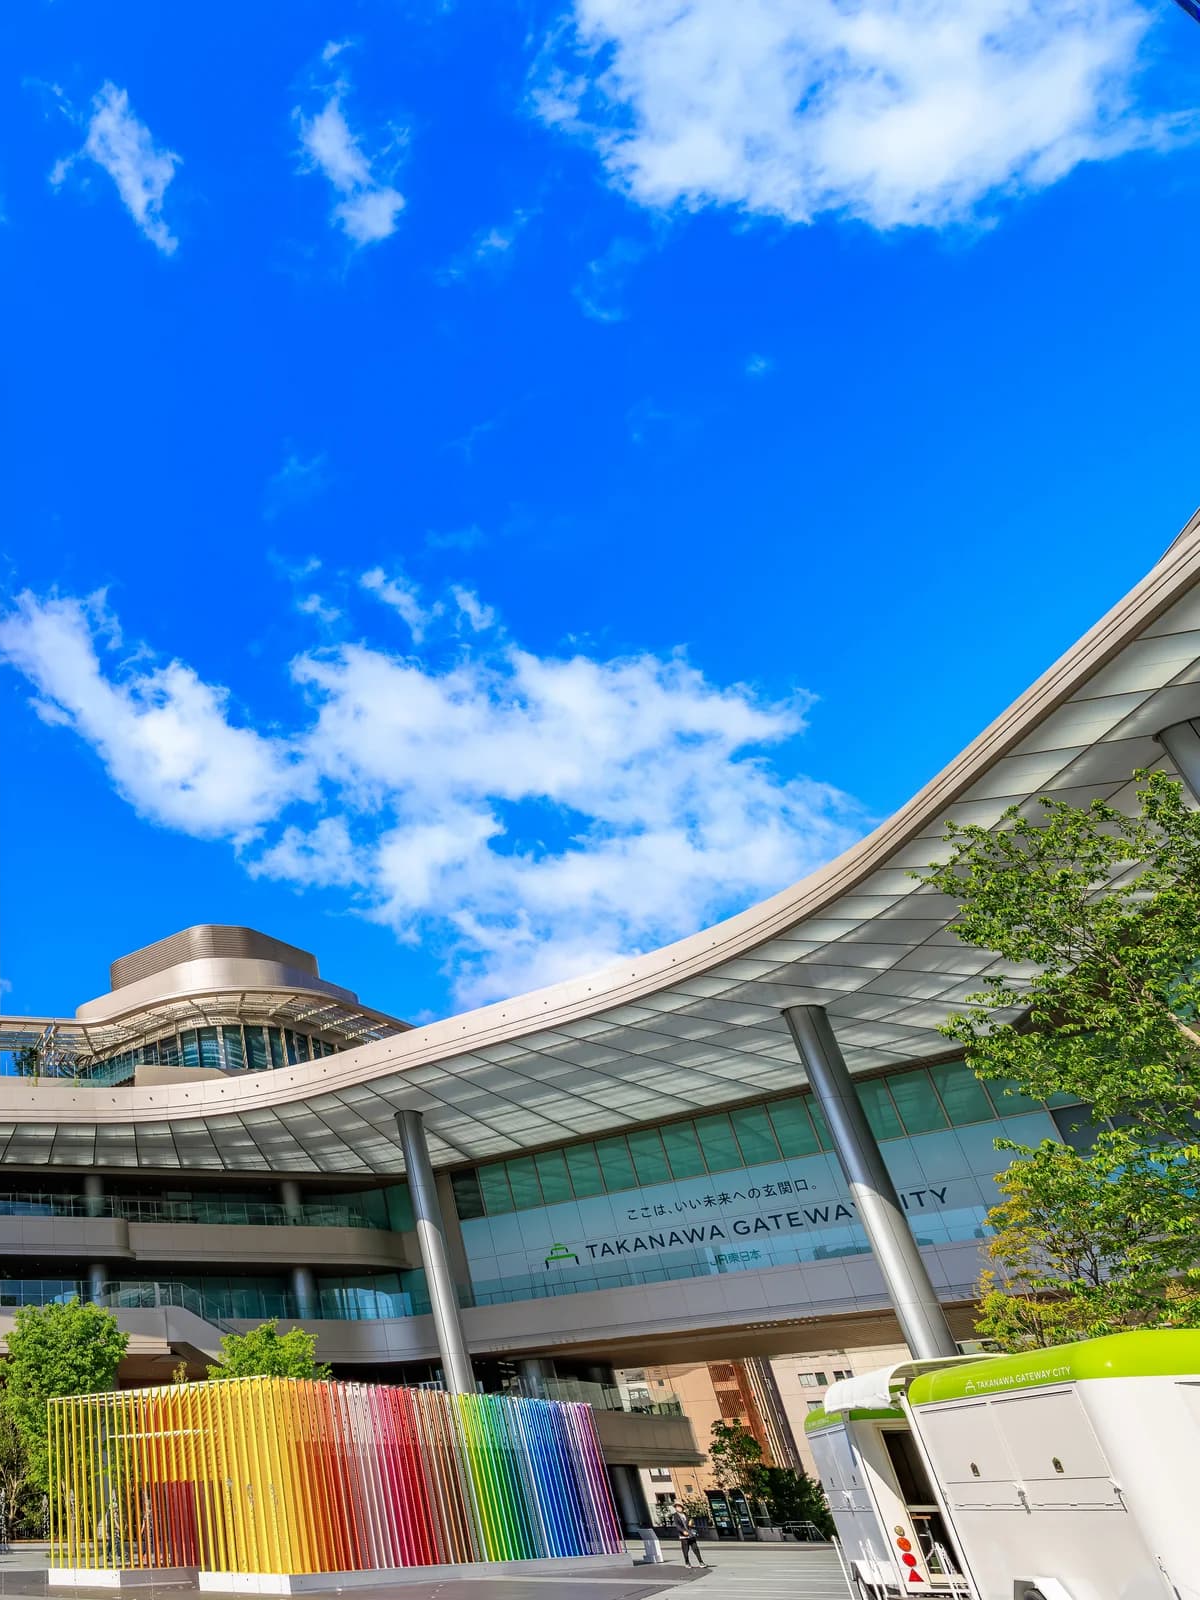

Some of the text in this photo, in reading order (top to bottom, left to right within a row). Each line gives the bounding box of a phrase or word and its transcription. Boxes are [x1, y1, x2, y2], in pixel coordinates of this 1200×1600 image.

[627, 1179, 817, 1221] ここは、いい未来への玄関口。
[585, 1187, 947, 1259] TAKANAWA GATEWA ITY
[710, 1249, 762, 1267] JR東日本
[976, 1366, 1071, 1390] TAKANAWA GATEWAY CITY
